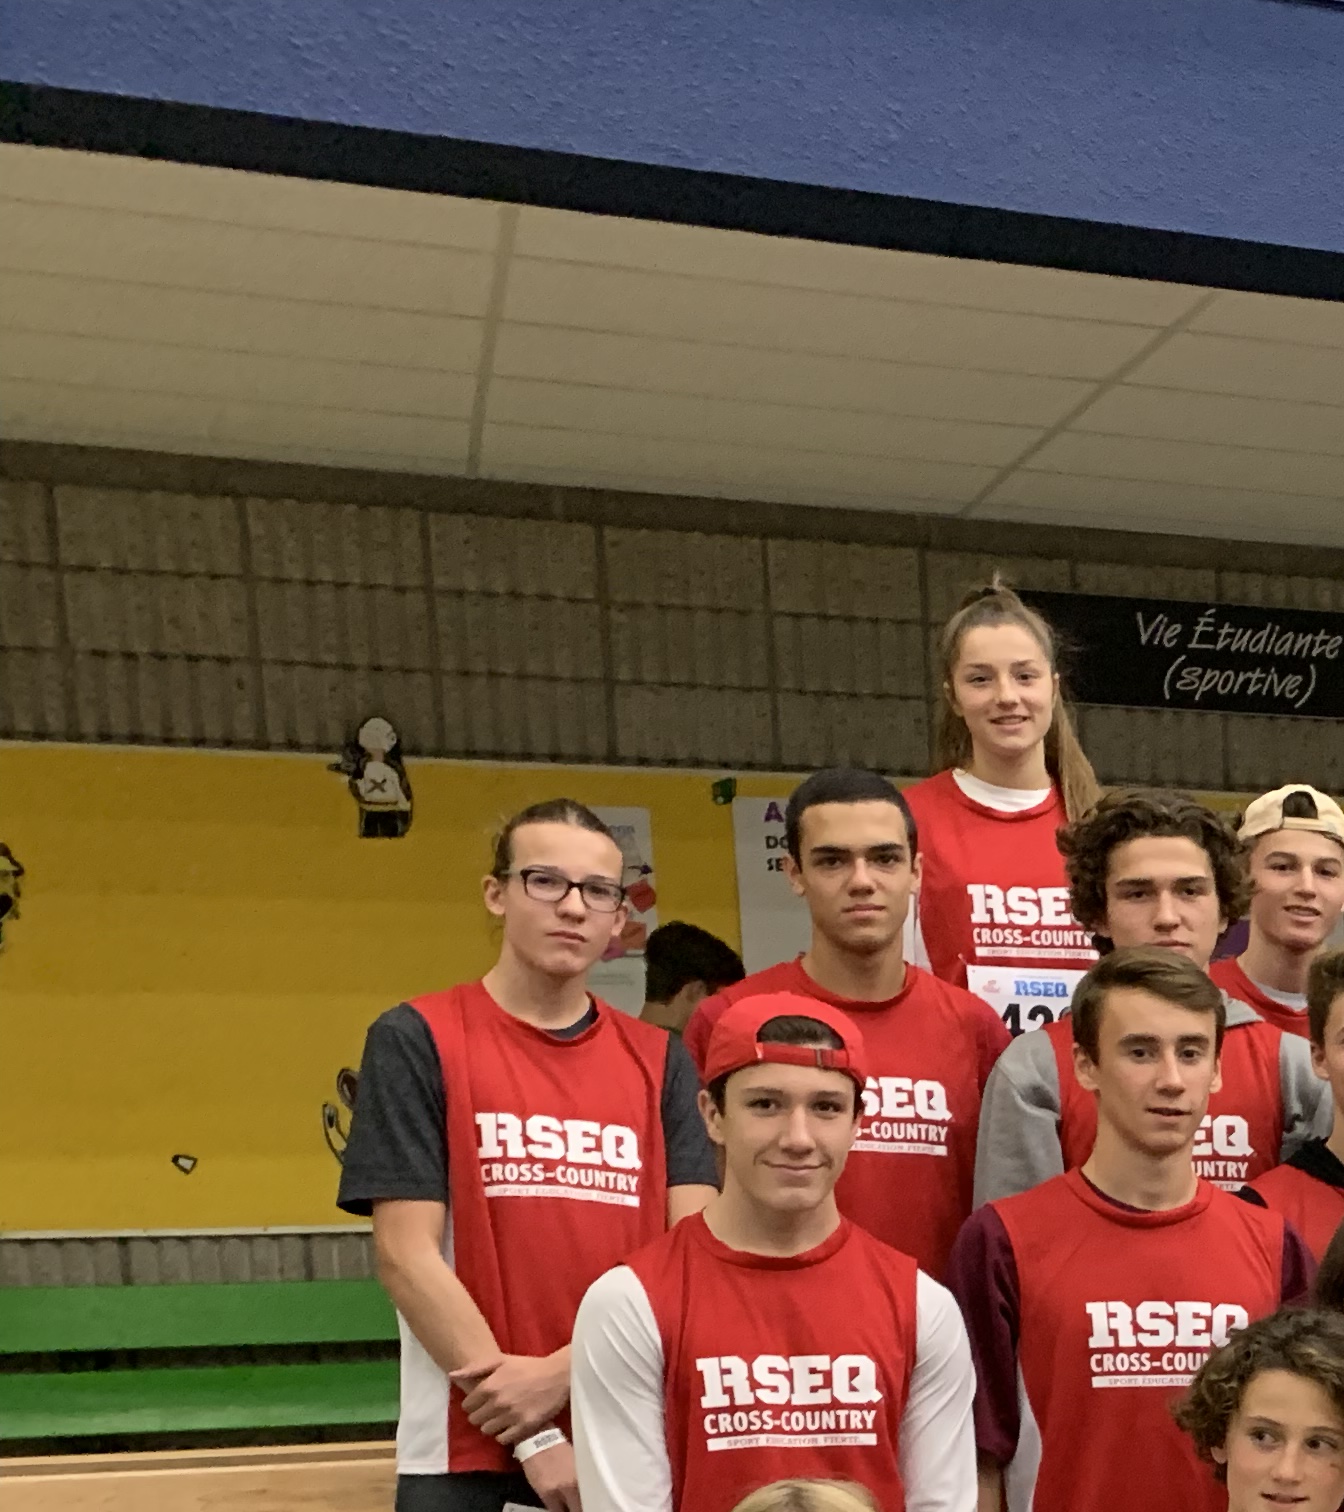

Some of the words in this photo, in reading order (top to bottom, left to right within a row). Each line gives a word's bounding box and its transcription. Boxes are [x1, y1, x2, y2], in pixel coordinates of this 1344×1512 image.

[1135, 611, 1181, 647] Vie
[1187, 608, 1344, 659] Étudiante
[1164, 654, 1316, 708] (sportive)
[966, 884, 1083, 926] RSE
[972, 928, 1096, 948] CROSS-COUNT
[1014, 980, 1069, 997] RSEQ
[475, 1112, 643, 1171] RSEQ
[856, 1120, 948, 1143] -COUNTRY
[481, 1162, 640, 1193] CROSS-COUNTRY
[1090, 1352, 1209, 1372] CROSS-COU
[695, 1354, 884, 1408] RSEQ
[703, 1409, 877, 1435] CROSS-COUNTRY
